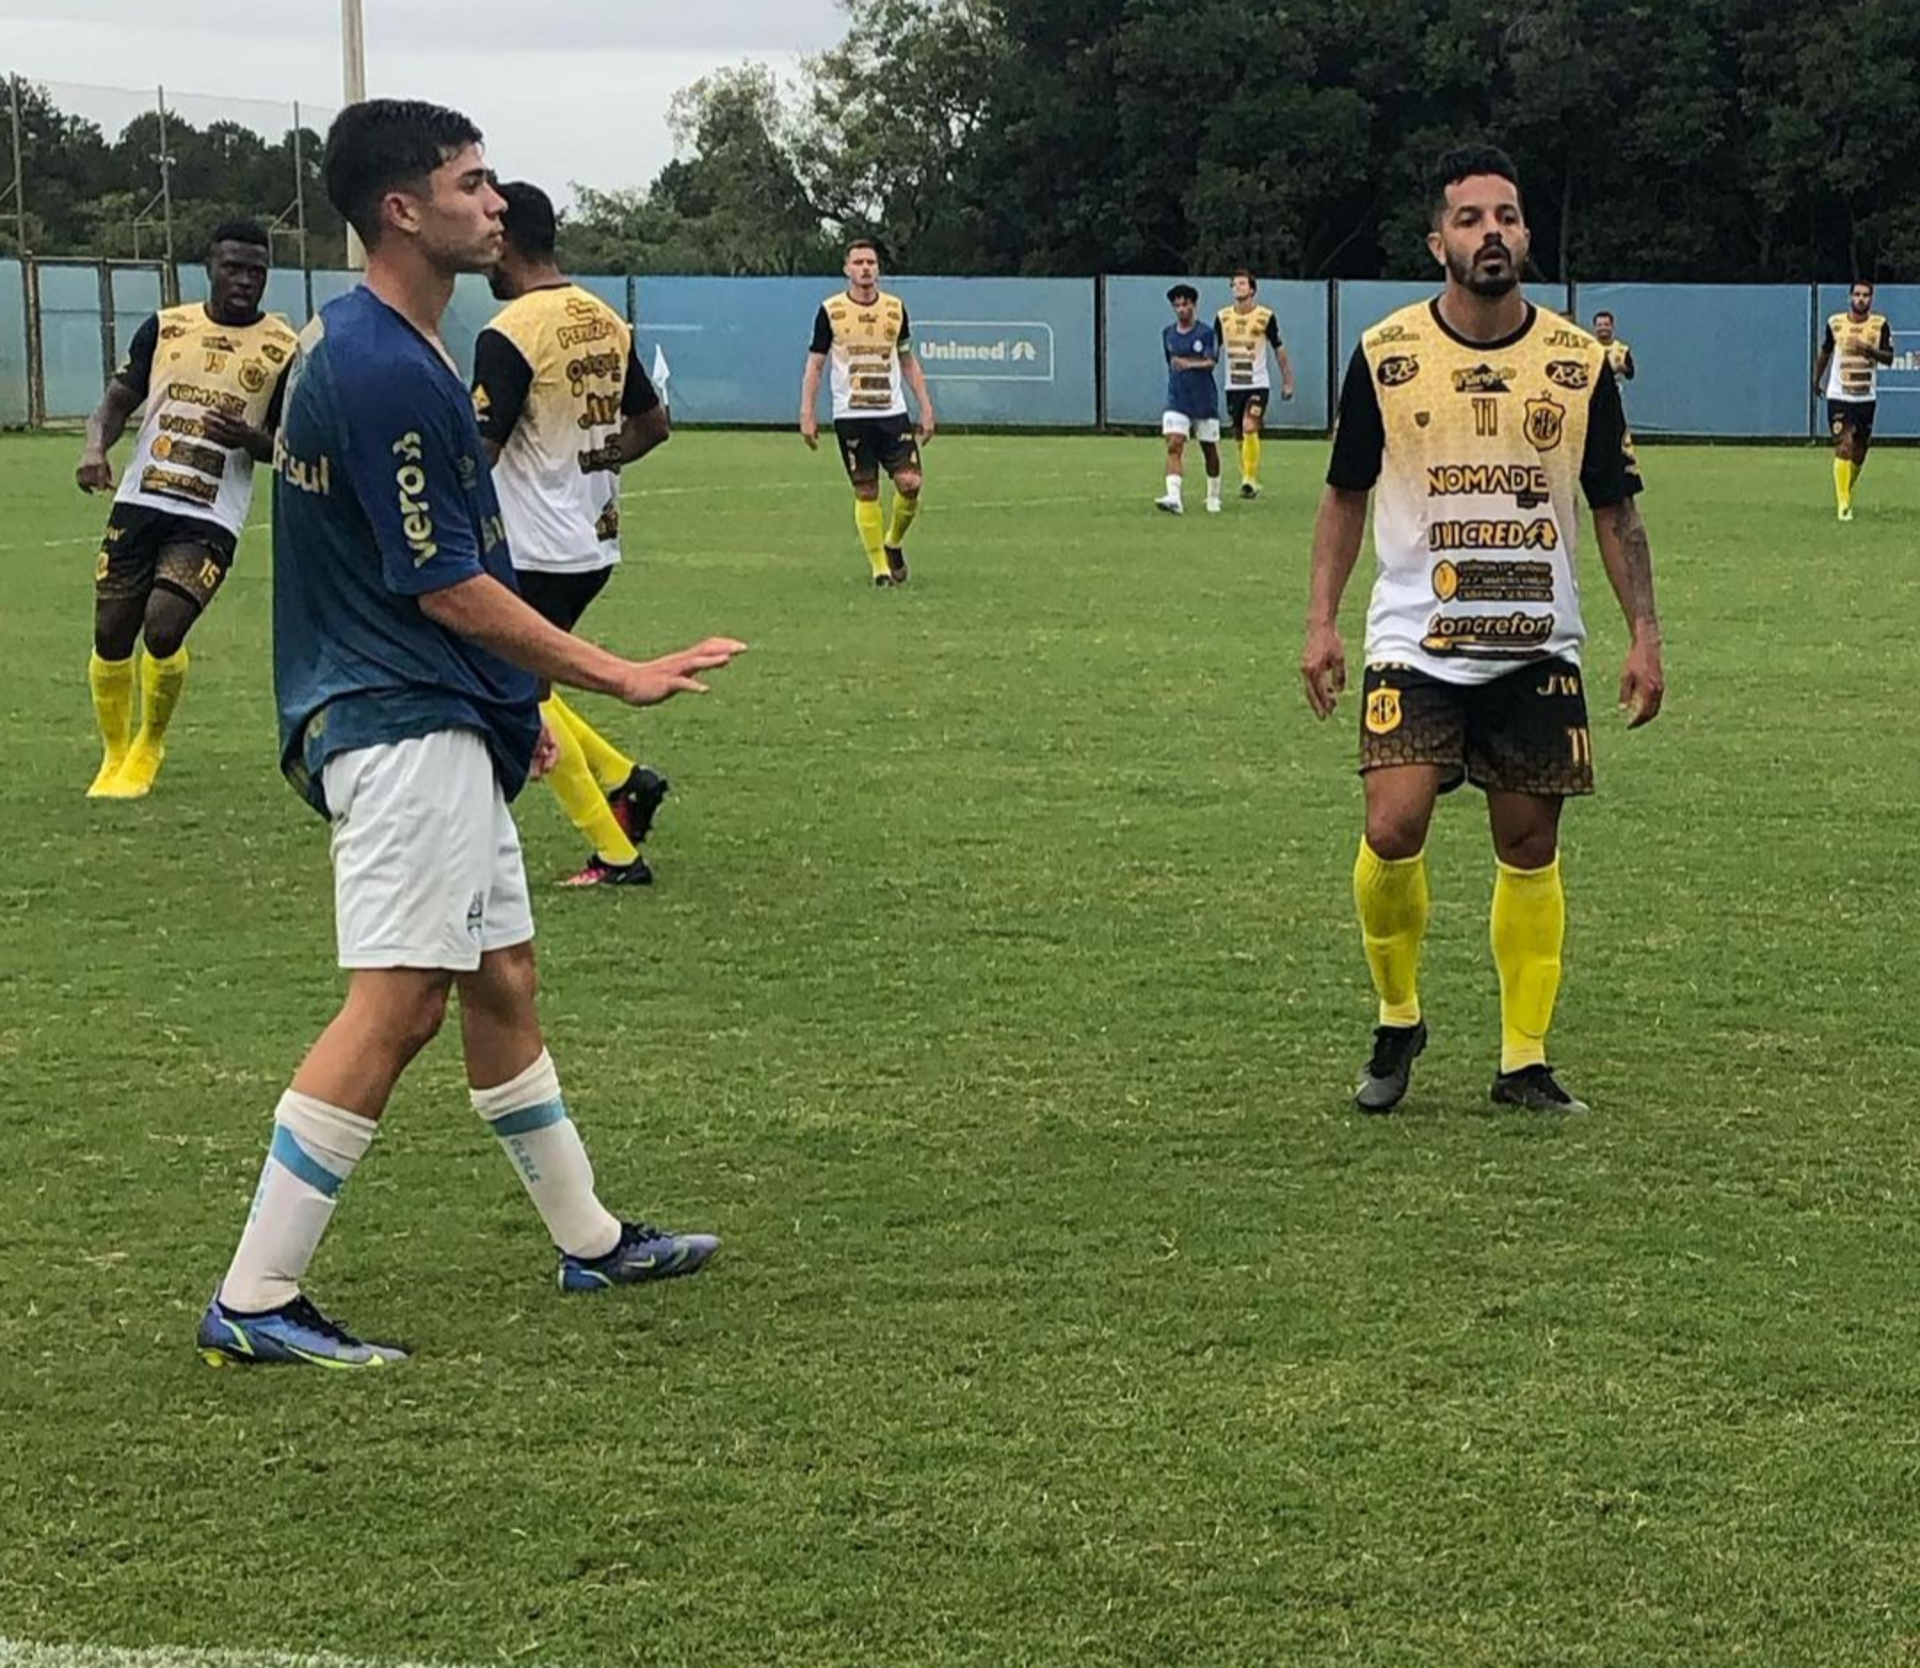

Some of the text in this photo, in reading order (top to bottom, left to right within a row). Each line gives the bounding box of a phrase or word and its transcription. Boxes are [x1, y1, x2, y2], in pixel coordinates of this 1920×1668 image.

[920, 340, 1005, 361] Unimed
[1471, 398, 1497, 436] 11
[1427, 465, 1549, 496] NOMADE
[397, 465, 437, 569] vero
[199, 559, 221, 588] 15
[1536, 676, 1579, 696] JW
[1567, 728, 1590, 767] 11
